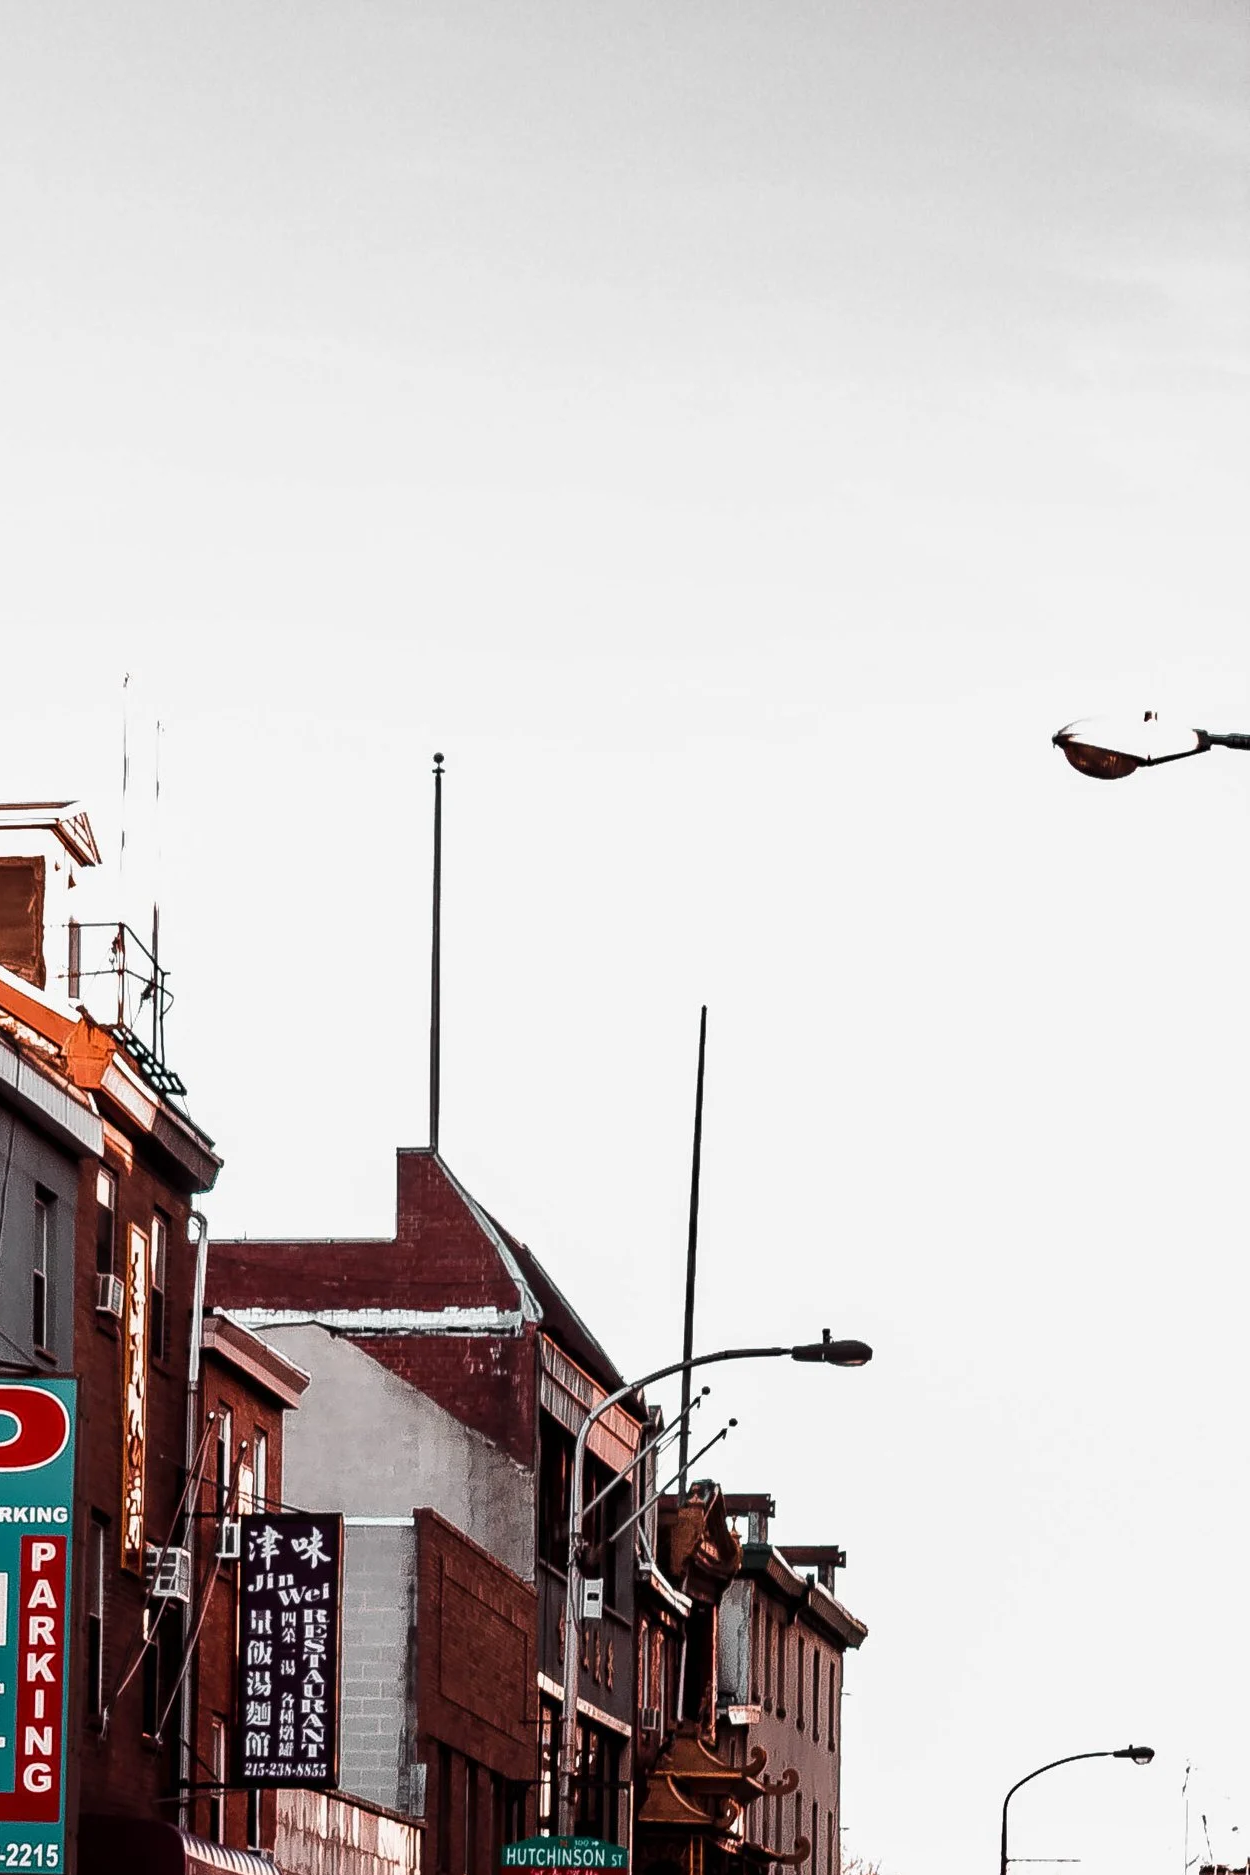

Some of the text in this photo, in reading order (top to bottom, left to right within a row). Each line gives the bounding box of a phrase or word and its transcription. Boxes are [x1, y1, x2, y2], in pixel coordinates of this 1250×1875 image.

[247, 1572, 330, 1606] Jin Wei
[23, 1542, 57, 1793] PARKING
[300, 1608, 328, 1758] RESTAURANT
[506, 1848, 623, 1866] HUTCHINSON ST
